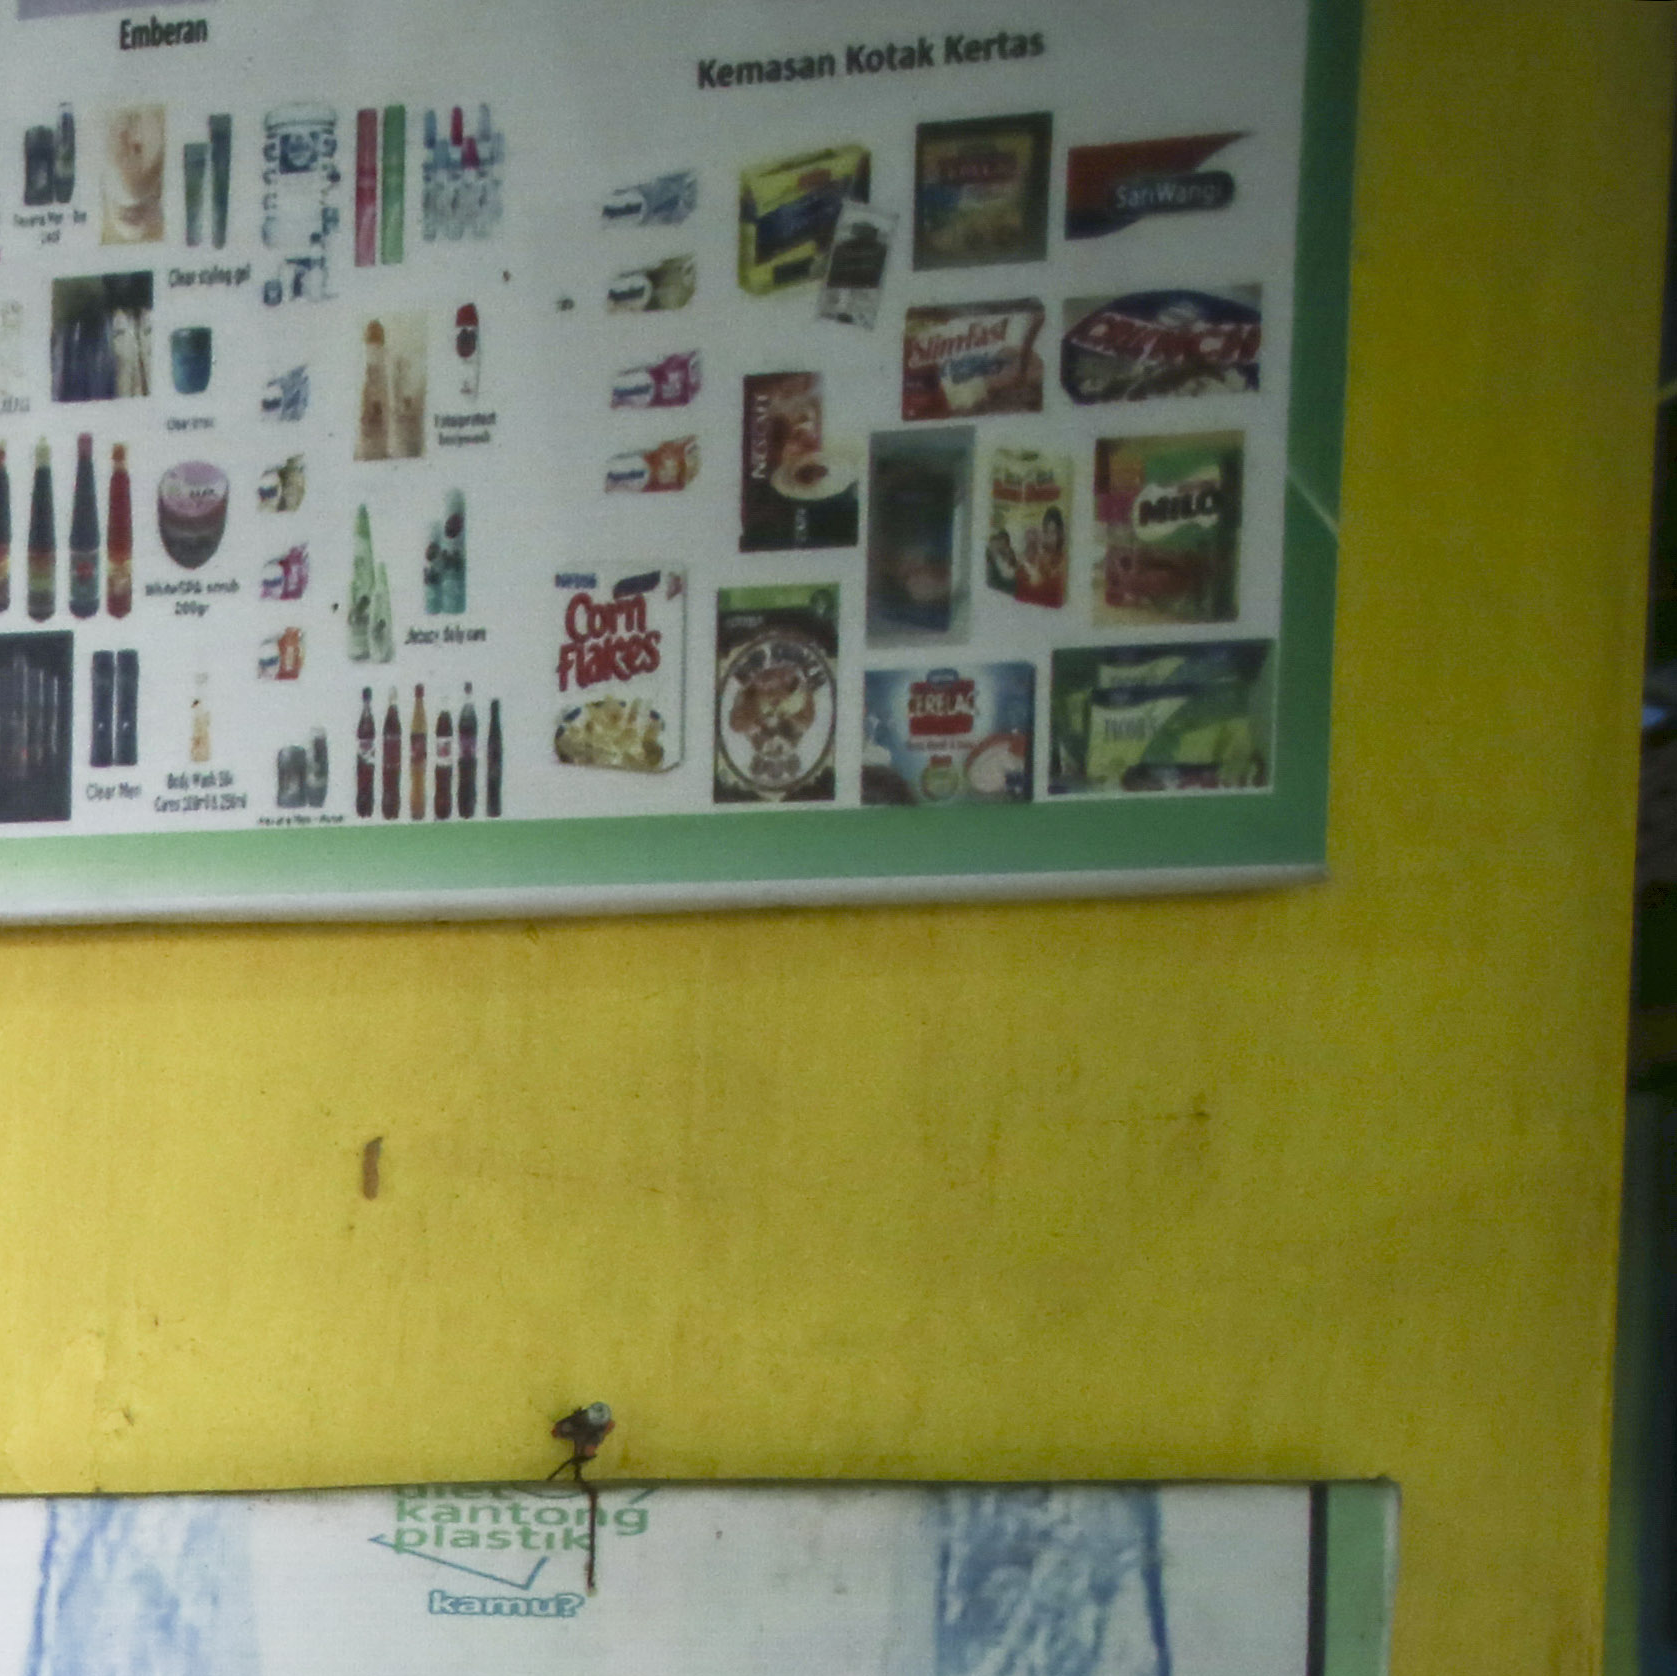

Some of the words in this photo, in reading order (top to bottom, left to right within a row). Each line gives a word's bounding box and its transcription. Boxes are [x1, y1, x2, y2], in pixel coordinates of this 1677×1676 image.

[119, 17, 208, 50] Emberan
[697, 52, 835, 89] Kemasan
[846, 39, 935, 74] Kotak
[944, 30, 1045, 66] Kertas
[168, 267, 195, 288] Clear
[564, 592, 647, 643] Corn
[85, 783, 116, 801] Clear
[397, 1499, 650, 1537] kantong
[394, 1523, 597, 1555] plastik
[428, 1588, 587, 1618] kamu?
